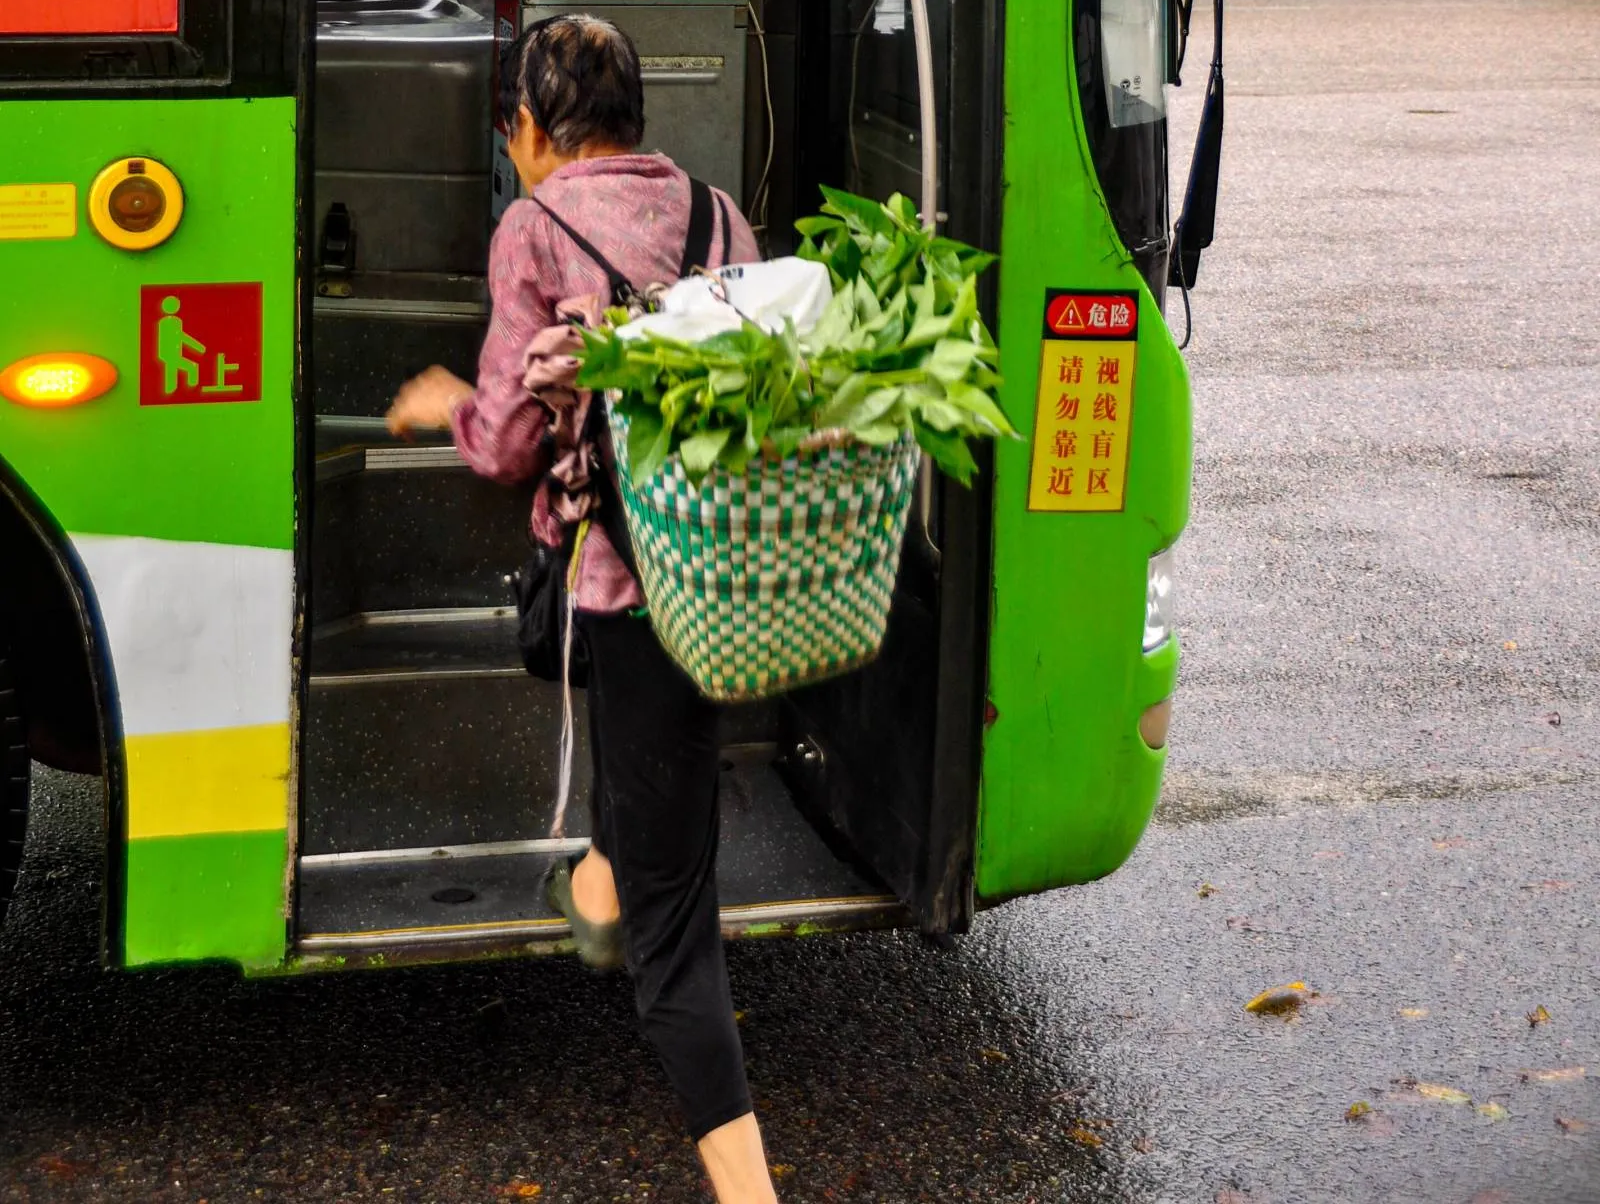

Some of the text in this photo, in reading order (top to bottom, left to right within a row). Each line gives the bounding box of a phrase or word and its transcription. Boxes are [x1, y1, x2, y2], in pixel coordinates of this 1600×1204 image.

[1087, 303, 1130, 328] 危险
[1047, 355, 1084, 495] 请勿靠近
[1086, 355, 1120, 495] 视线盲区
